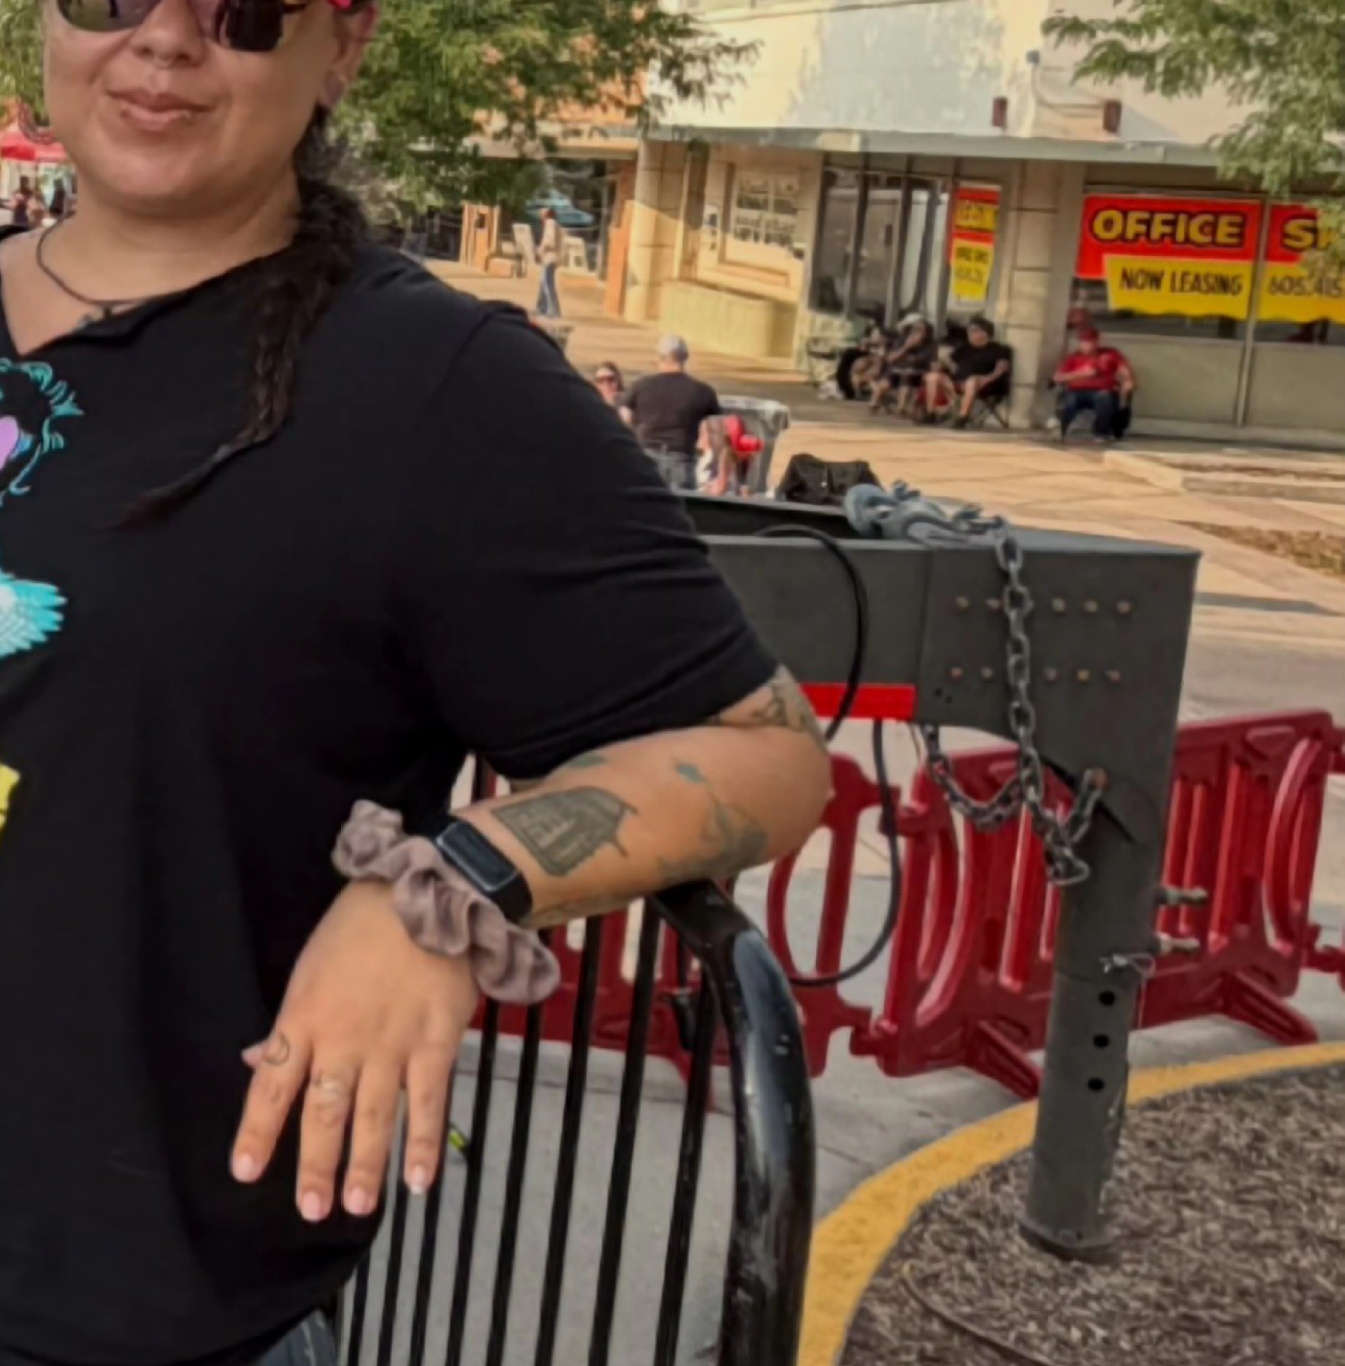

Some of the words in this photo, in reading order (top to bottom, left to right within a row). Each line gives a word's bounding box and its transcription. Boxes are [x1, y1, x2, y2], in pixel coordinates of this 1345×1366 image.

[1090, 208, 1246, 249] OFFICE
[1119, 267, 1165, 292] NOW
[1171, 270, 1243, 297] LEASING
